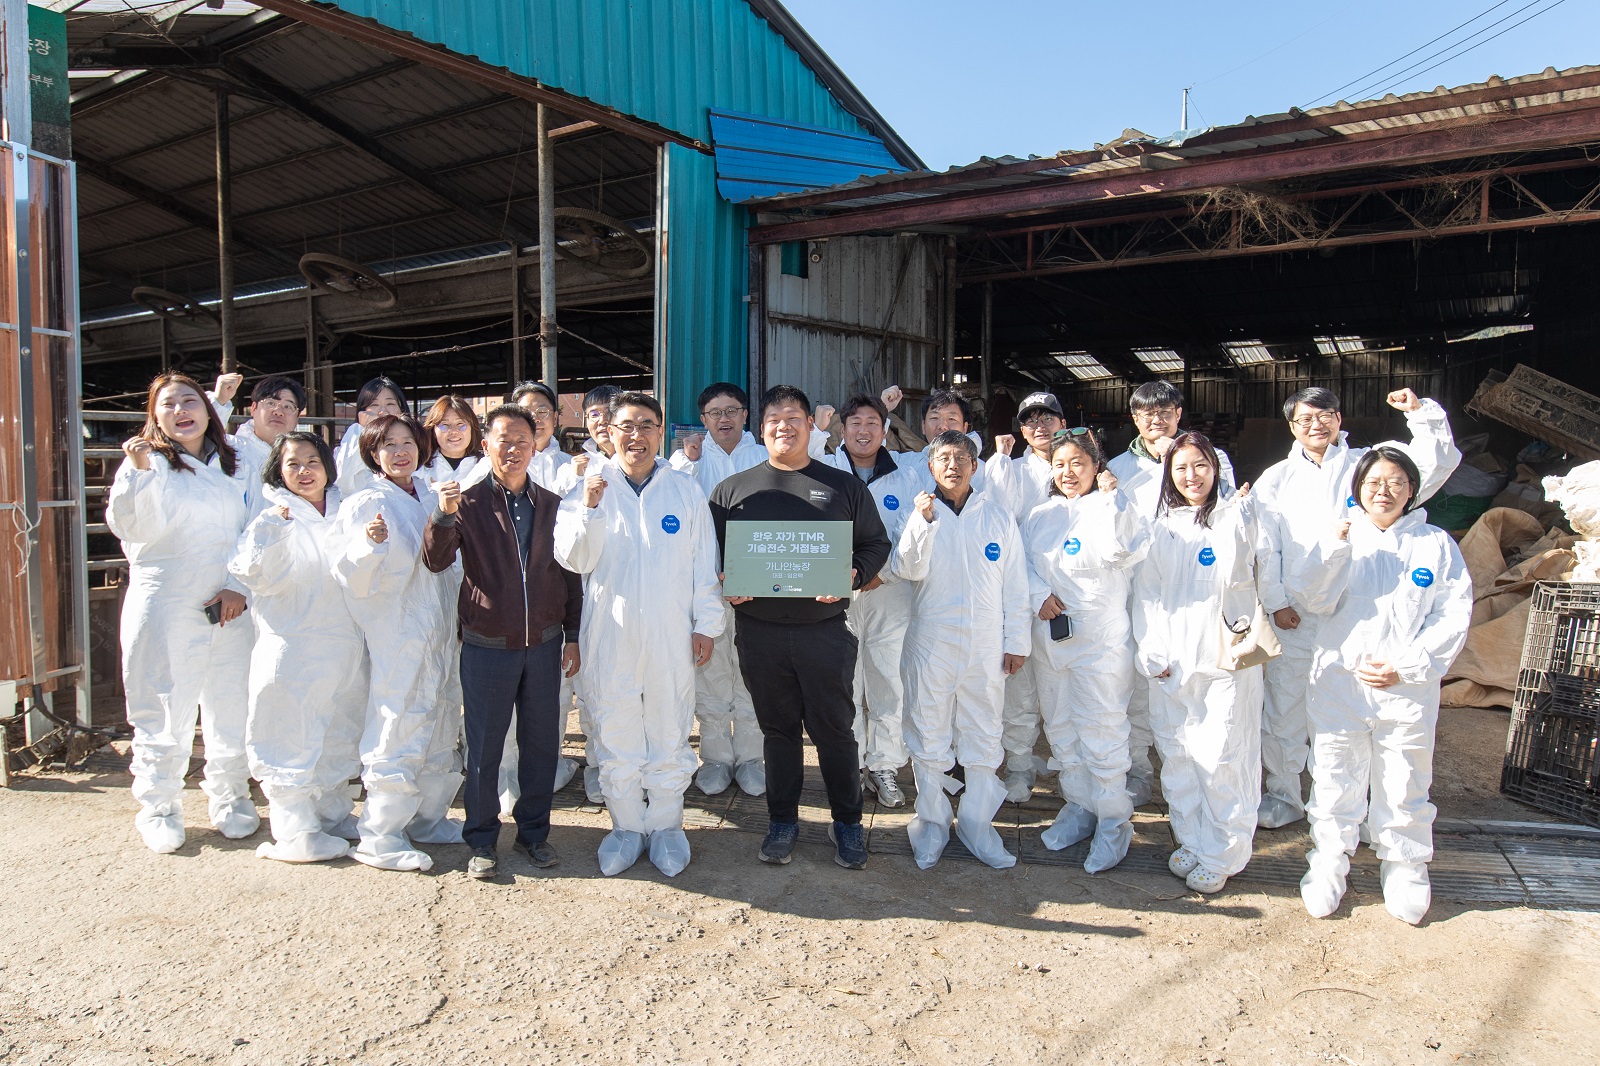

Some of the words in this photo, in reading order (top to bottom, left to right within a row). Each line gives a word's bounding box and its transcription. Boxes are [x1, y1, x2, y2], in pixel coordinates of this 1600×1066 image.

[753, 531, 773, 541] 한우
[775, 531, 796, 541] 자가
[798, 532, 825, 541] TMR
[747, 543, 787, 553] 기술전수
[790, 543, 830, 554] 거점농장
[765, 561, 811, 571] 가나안농장
